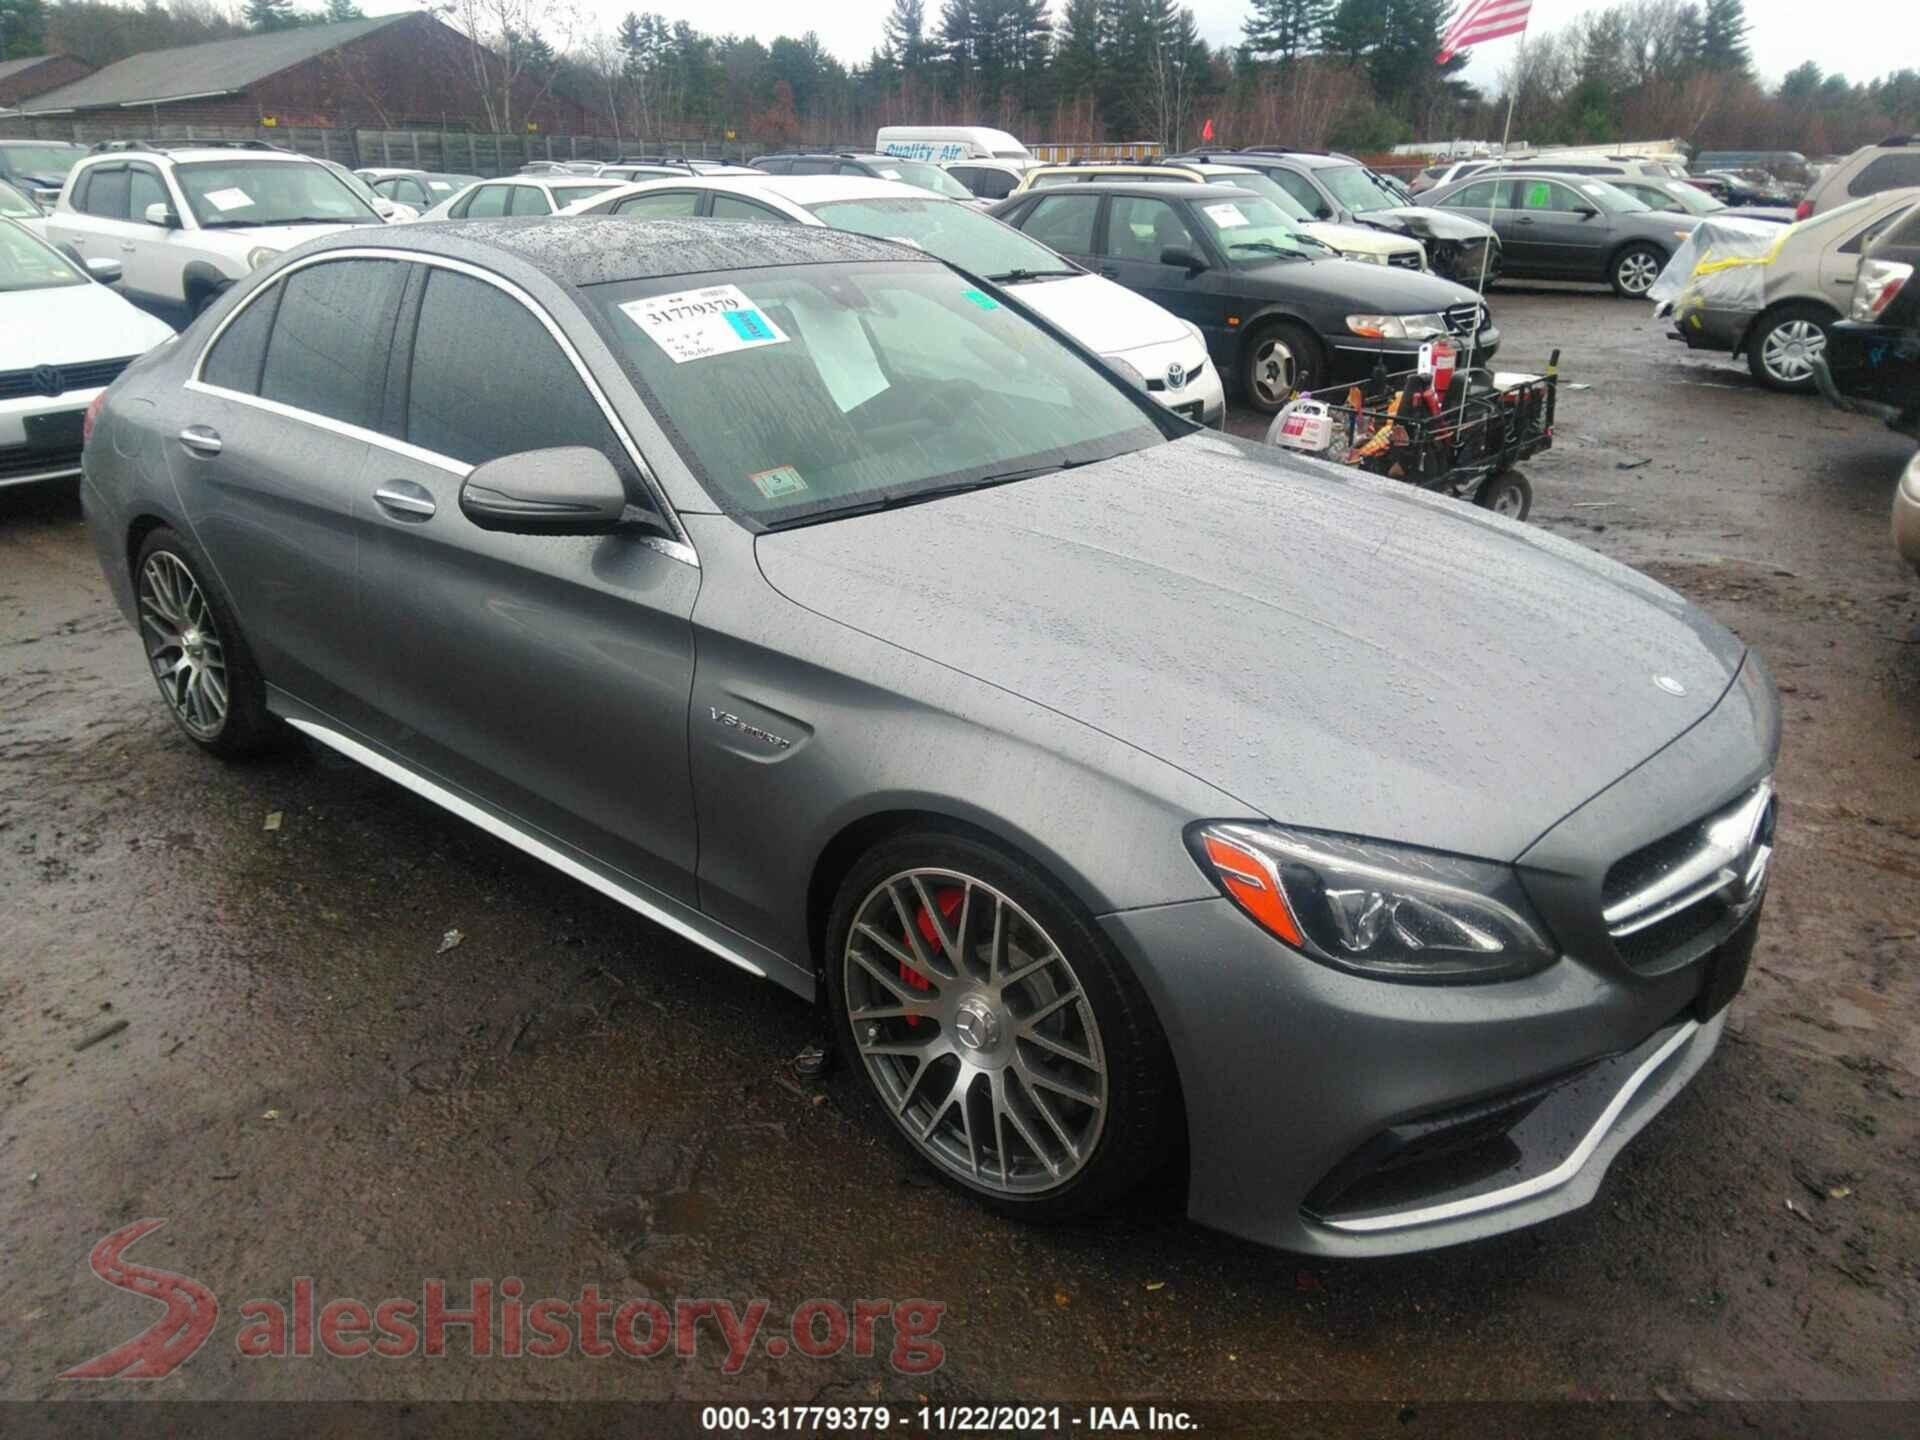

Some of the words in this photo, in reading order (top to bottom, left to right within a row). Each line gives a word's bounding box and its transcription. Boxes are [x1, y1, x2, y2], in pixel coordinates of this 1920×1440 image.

[887, 144, 935, 161] Quality
[940, 144, 962, 160] Air
[647, 298, 740, 325] 31779379
